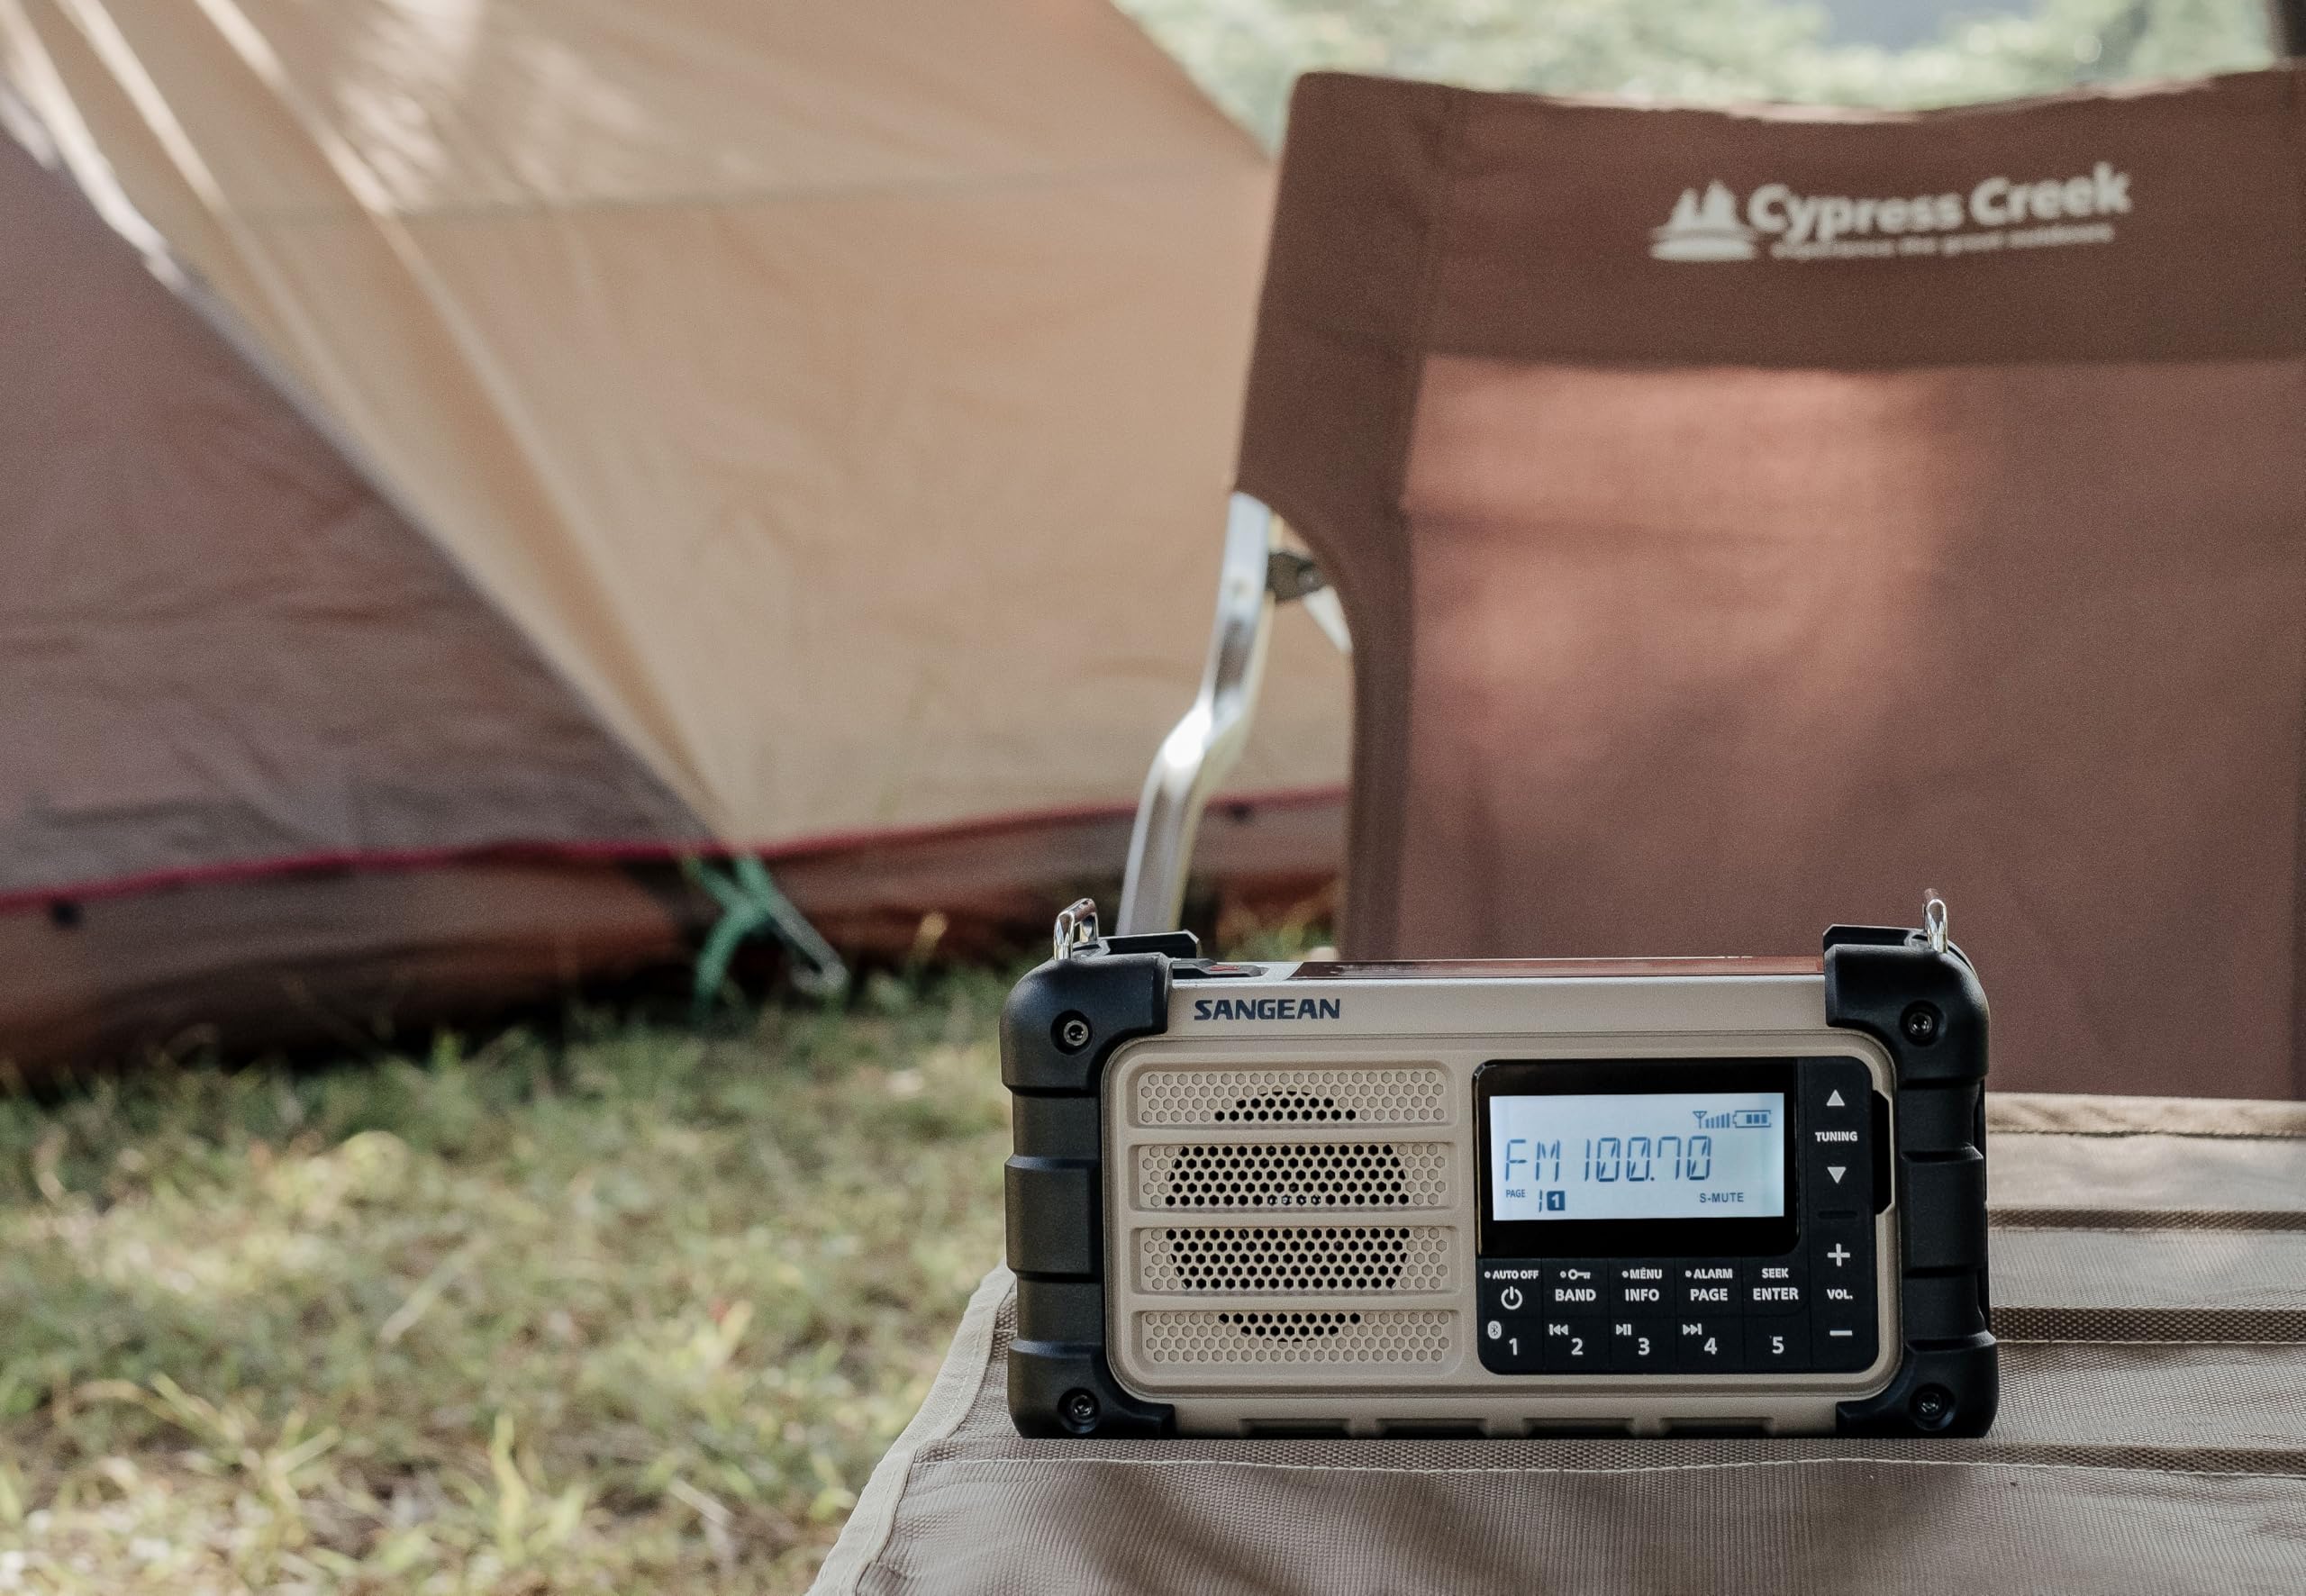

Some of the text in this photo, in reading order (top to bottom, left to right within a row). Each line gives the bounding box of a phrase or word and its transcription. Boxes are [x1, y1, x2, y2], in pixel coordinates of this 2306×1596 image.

[1747, 182, 1965, 241] Cypress
[1970, 160, 2133, 226] Creek
[1194, 998, 1340, 1020] SANGEAN
[1814, 1130, 1858, 1142] TUNING
[1504, 1135, 1711, 1183] FM 100.70
[1505, 1189, 1526, 1199] PAGE
[1548, 1192, 1563, 1211] 1
[1699, 1192, 1745, 1203] S-MUTE
[1492, 1269, 1539, 1280] AUTO OFF
[1630, 1267, 1663, 1280] MENU
[1693, 1268, 1733, 1280] ALARM
[1761, 1267, 1789, 1279] SEEK
[1555, 1288, 1597, 1301] BAND
[1624, 1288, 1660, 1301] INFO
[1690, 1288, 1729, 1301] PAGE
[1753, 1287, 1799, 1301] ENTER
[1826, 1288, 1854, 1300] VOL.
[1509, 1338, 1518, 1356] 1
[1571, 1338, 1584, 1356] 2
[1638, 1337, 1650, 1356] 3
[1703, 1337, 1718, 1355] 4
[1772, 1336, 1784, 1355] 5
